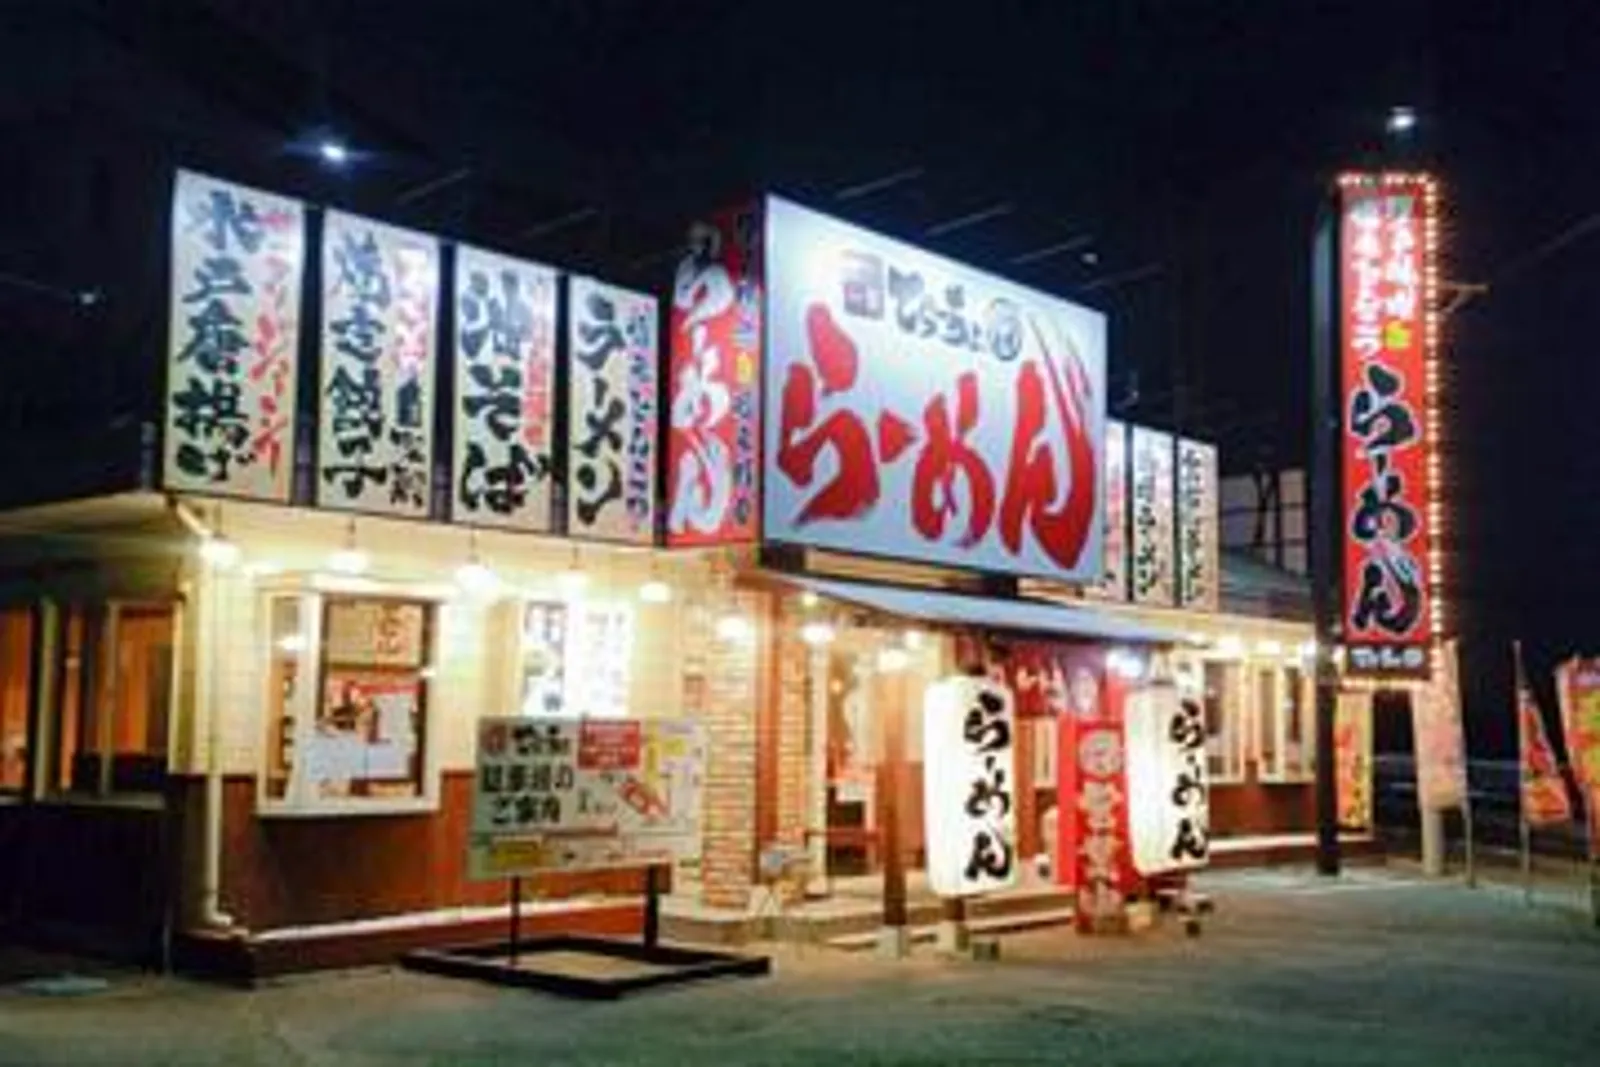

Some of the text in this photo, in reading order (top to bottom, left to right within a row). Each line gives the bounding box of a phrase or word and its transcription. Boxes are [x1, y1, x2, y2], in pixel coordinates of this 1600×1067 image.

[324, 231, 390, 499] 焼き餃子
[460, 270, 552, 514] 油そば
[574, 292, 626, 525] ラーメン
[778, 303, 1098, 570] らーめん
[963, 691, 1011, 881] らーめん
[1169, 701, 1207, 859] らーめん
